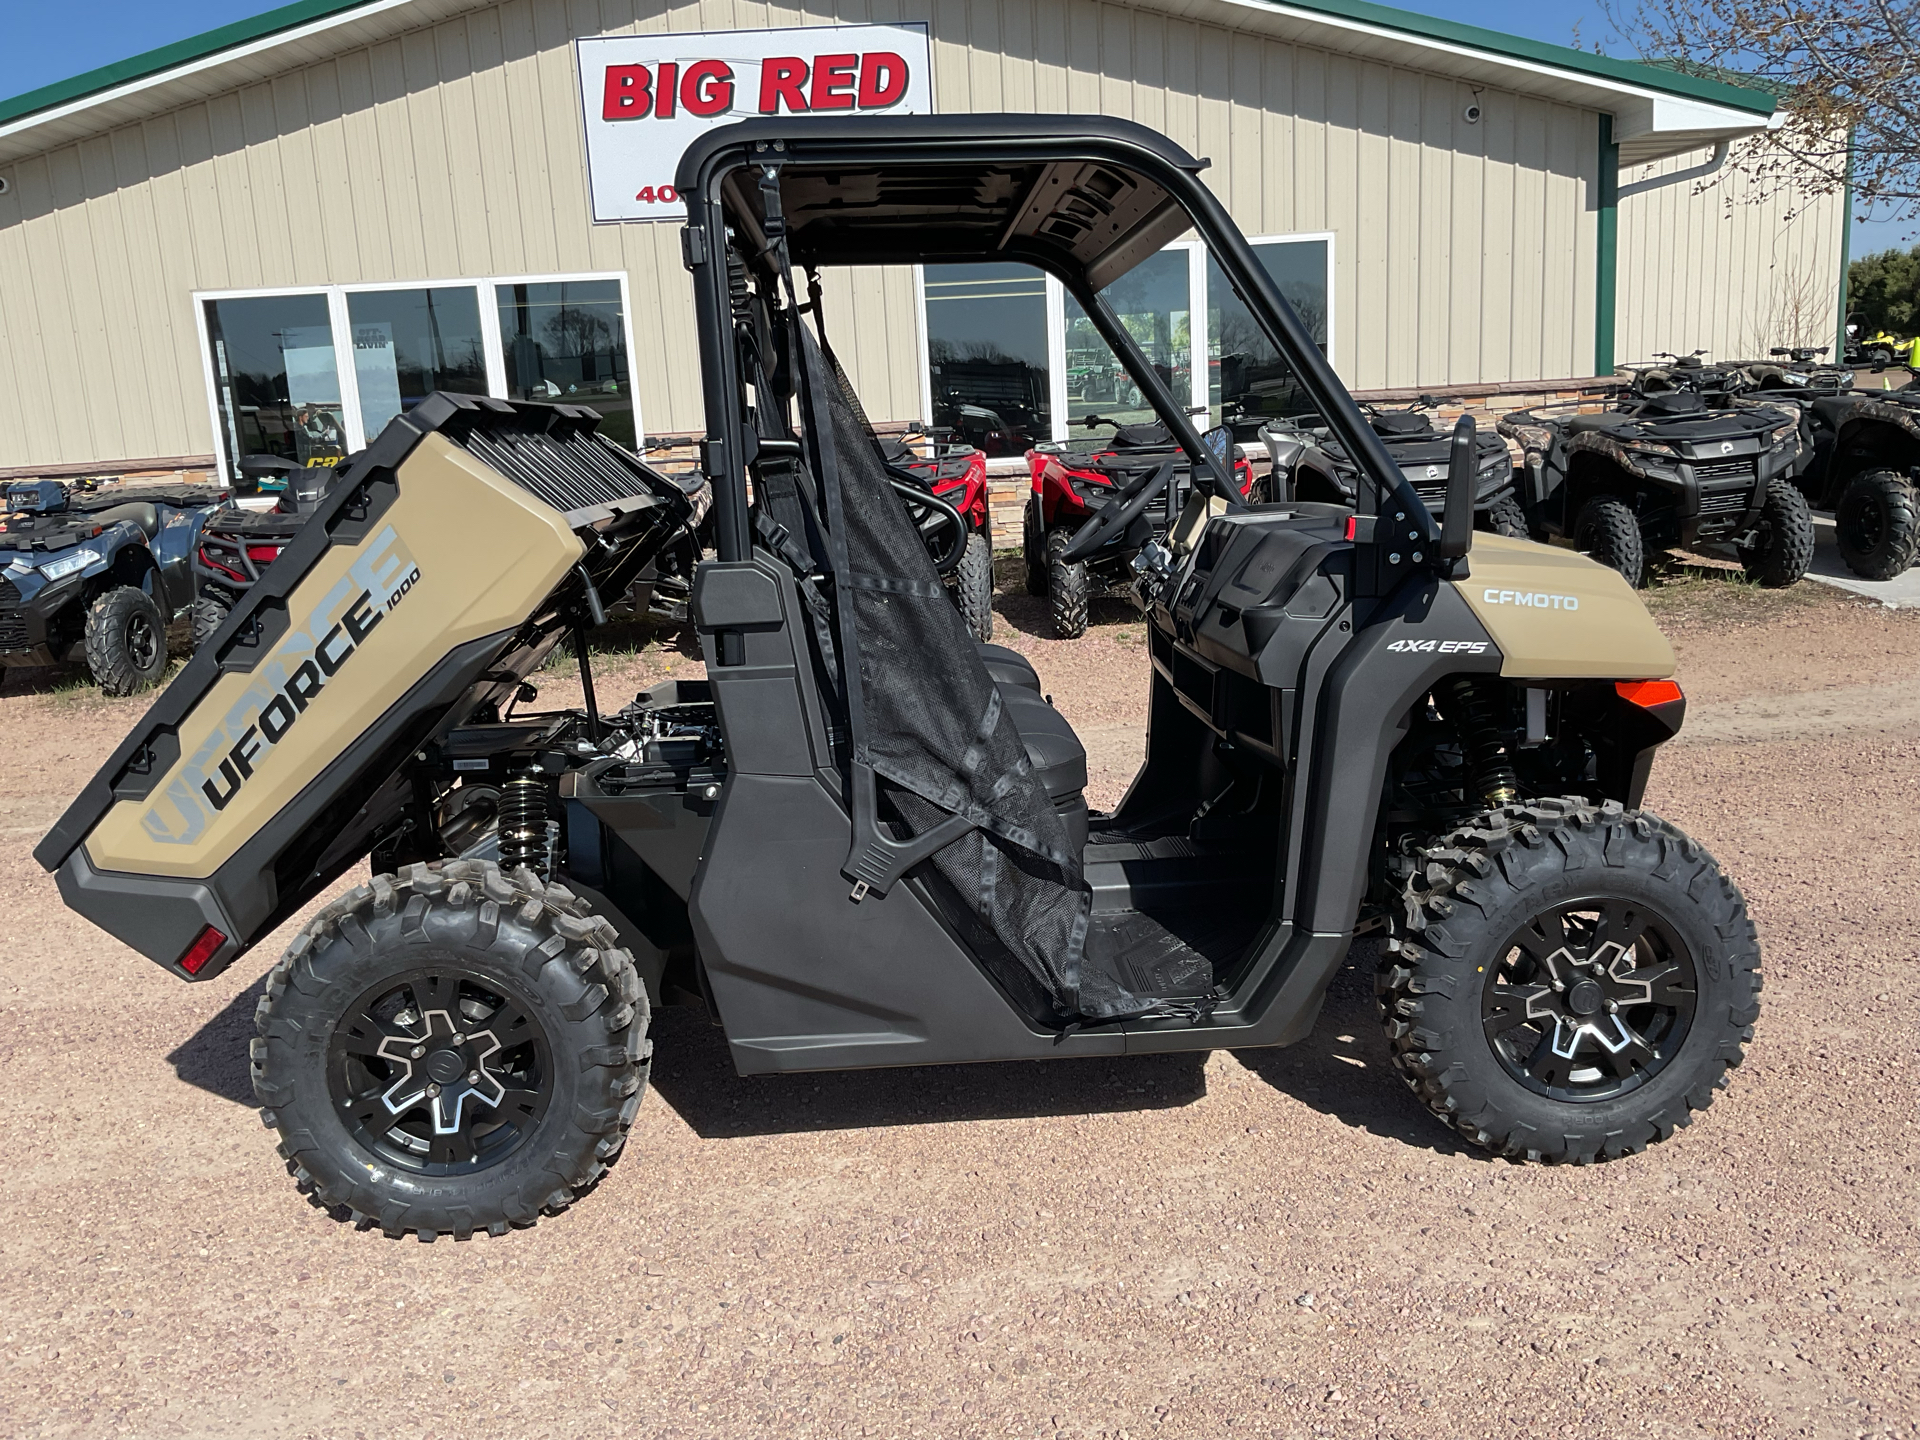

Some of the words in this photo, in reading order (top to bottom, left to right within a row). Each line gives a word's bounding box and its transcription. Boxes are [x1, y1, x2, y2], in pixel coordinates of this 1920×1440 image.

[602, 60, 736, 122] BIG
[758, 52, 909, 115] RED
[636, 185, 685, 204] 40
[355, 341, 388, 349] LIVIN'
[1484, 589, 1578, 610] CFMOTO
[1387, 640, 1437, 652] 4X4
[1438, 641, 1489, 654] EPS
[201, 588, 384, 811] UFORCE
[387, 567, 421, 611] 1000
